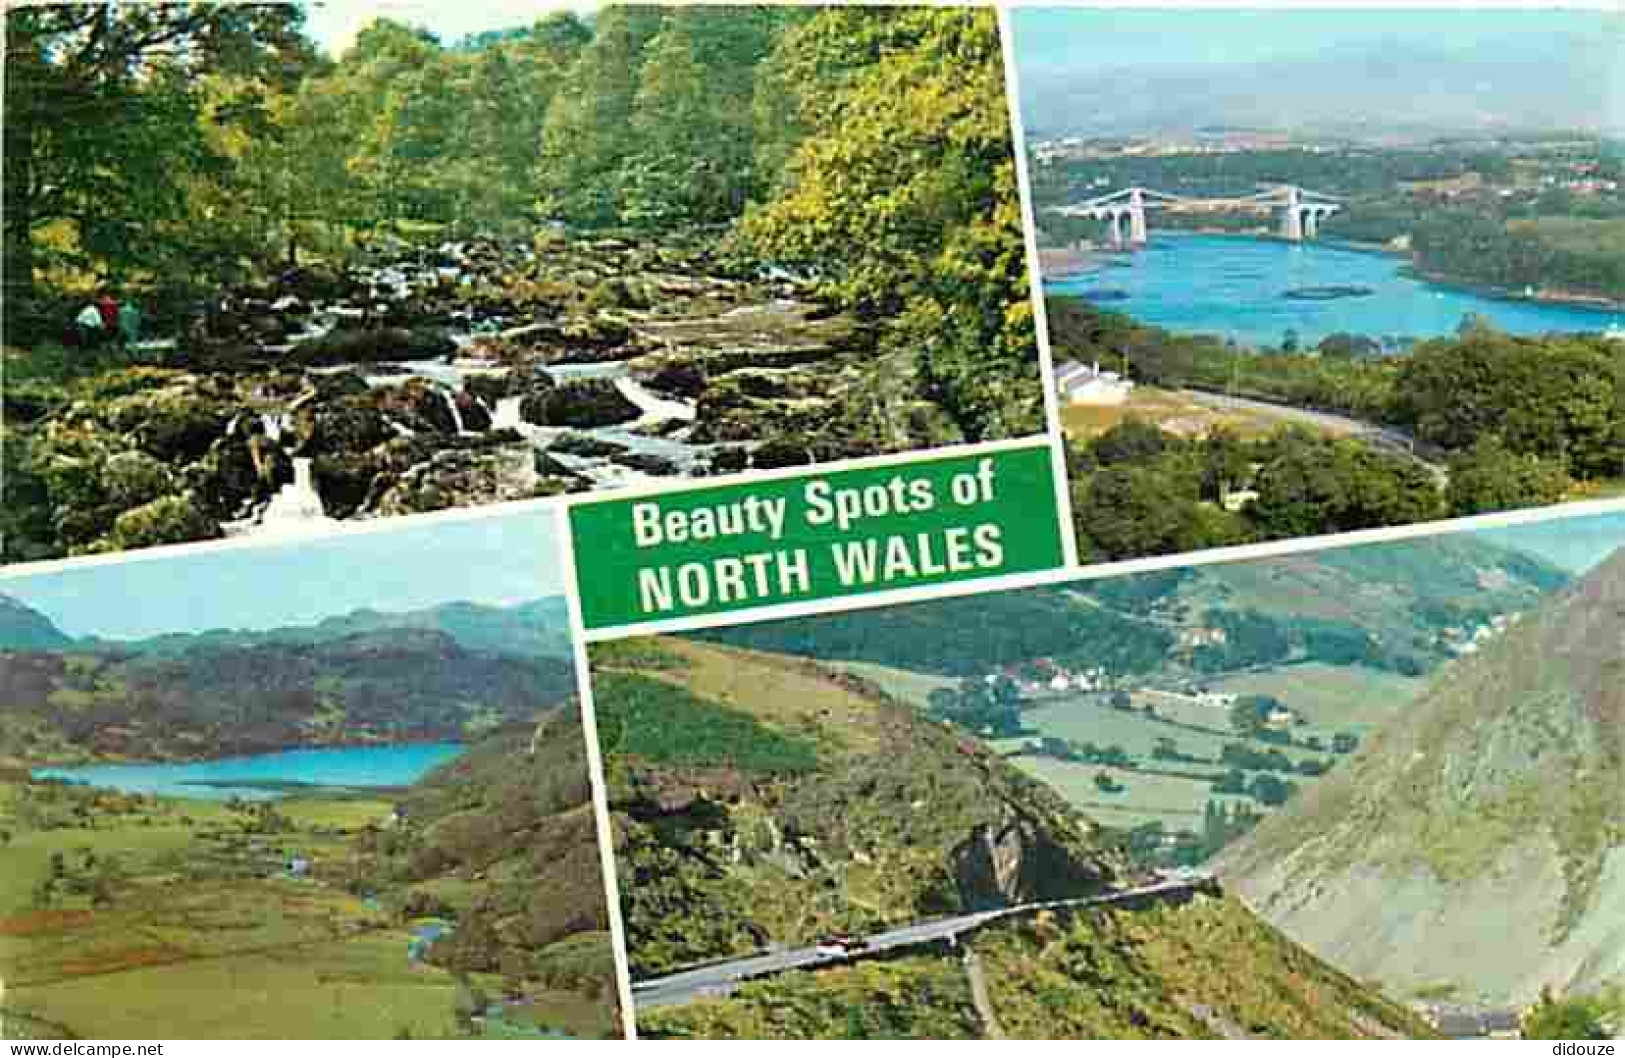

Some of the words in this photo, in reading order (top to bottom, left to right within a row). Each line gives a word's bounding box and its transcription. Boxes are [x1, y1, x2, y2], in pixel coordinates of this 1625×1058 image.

[632, 495, 786, 548] Beauty
[804, 477, 935, 531] Spots
[952, 459, 997, 505] of
[636, 548, 811, 613] NORTH
[832, 523, 1004, 586] WALES
